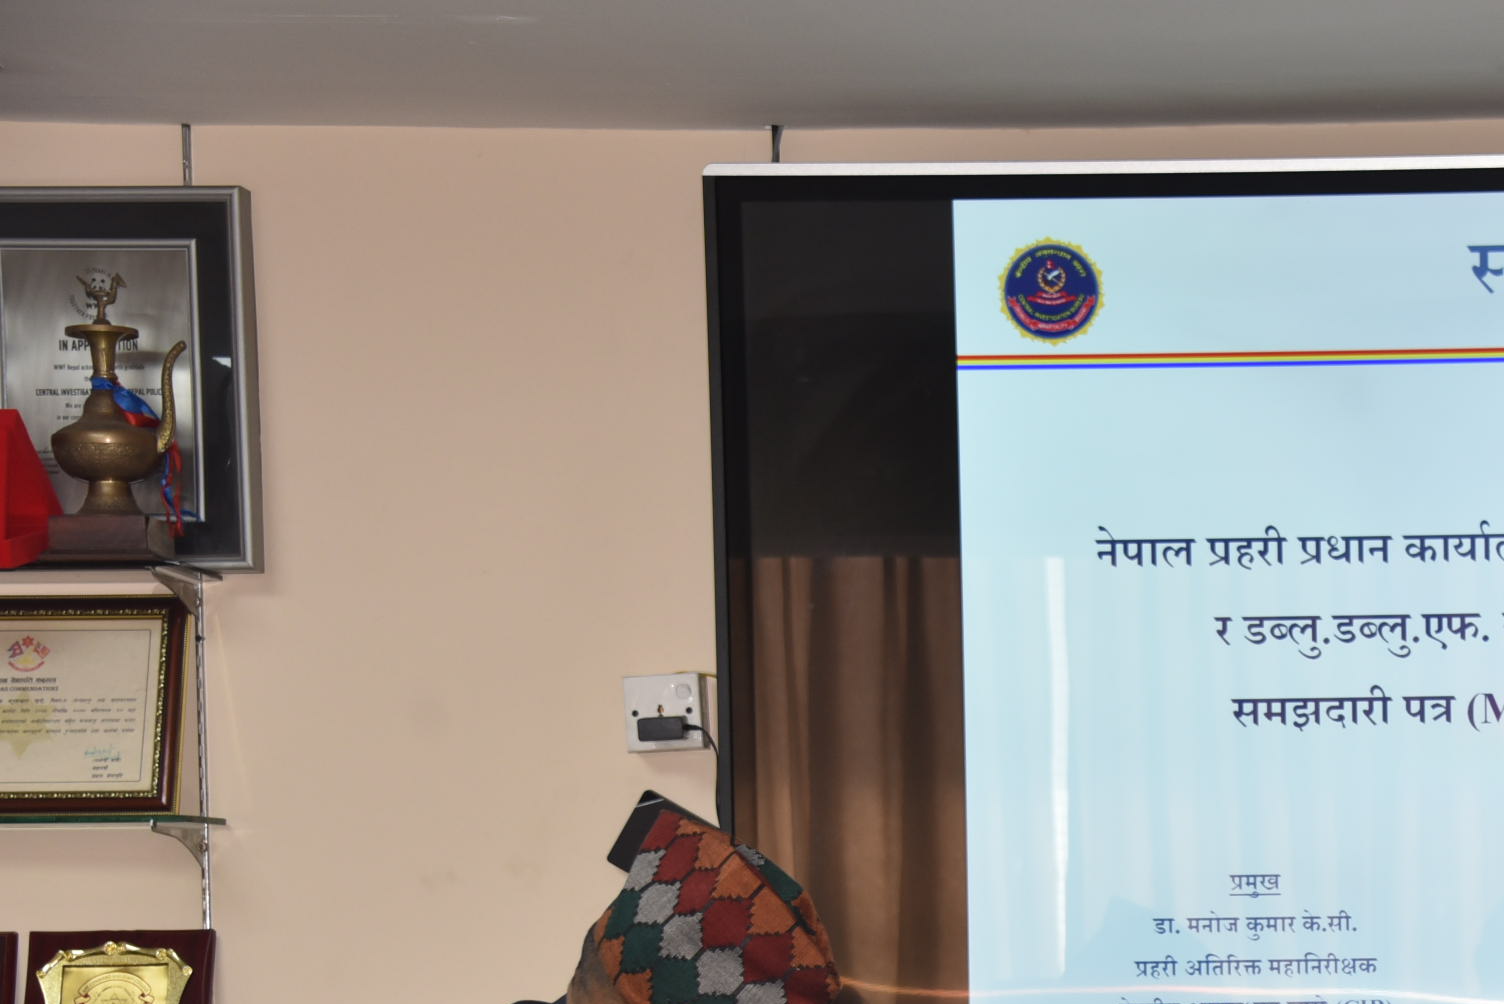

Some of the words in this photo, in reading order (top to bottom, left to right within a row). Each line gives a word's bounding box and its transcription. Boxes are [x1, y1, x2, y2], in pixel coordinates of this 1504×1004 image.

[59, 340, 68, 351] IN
[71, 339, 138, 351] APPTION
[1096, 526, 1196, 566] नेपाल
[1206, 525, 1287, 569] प्रहरी
[1297, 536, 1392, 564] प्रधान
[1214, 617, 1232, 645] र
[1242, 613, 1489, 659] डब्लु.डब्लु.एफ.
[1231, 685, 1392, 731] समझदारी
[1402, 696, 1456, 723] पत्र
[1230, 874, 1280, 898] प्रमुख
[1153, 918, 1180, 934] डा.
[1187, 911, 1239, 932] मनोज
[1246, 917, 1296, 941] कुमार
[1302, 910, 1356, 932] के.सी.
[1134, 955, 1178, 977] प्रहरी
[1186, 954, 1262, 975] अतिरिक्त
[1268, 952, 1377, 975] महानिरीक्षक
